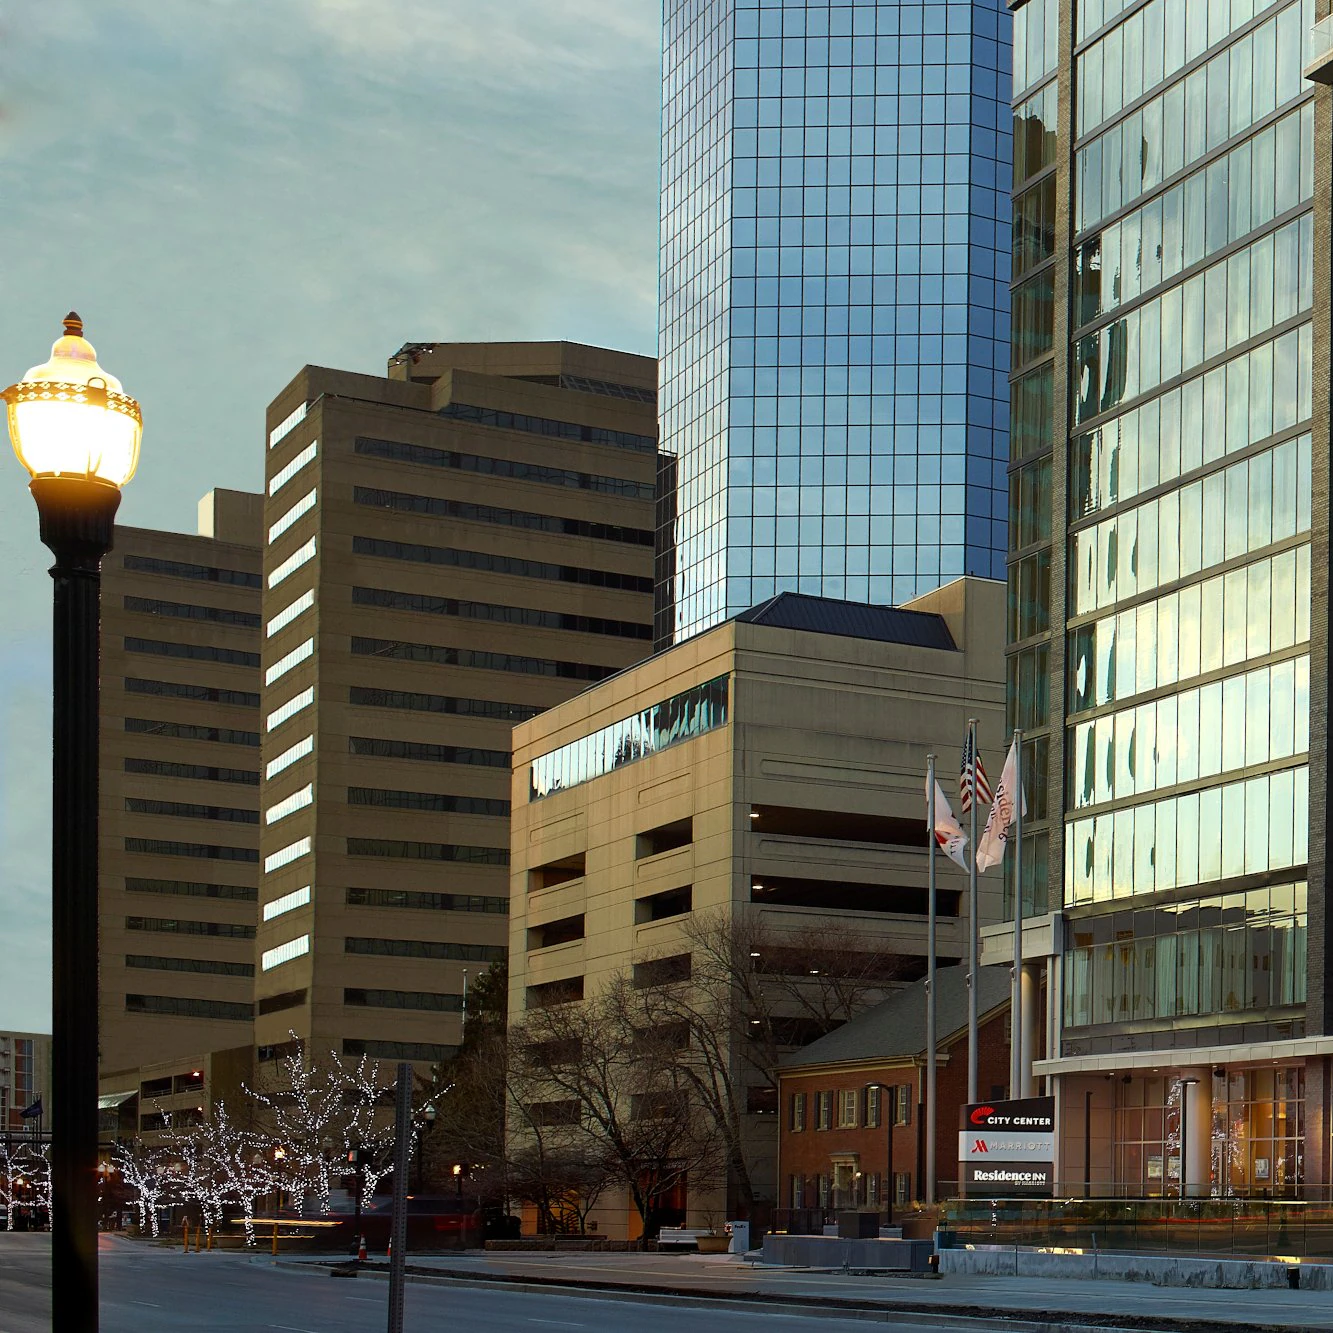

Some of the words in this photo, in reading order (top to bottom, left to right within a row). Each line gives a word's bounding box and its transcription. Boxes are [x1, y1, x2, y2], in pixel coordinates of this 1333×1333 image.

[987, 1116, 1011, 1125] CITY
[1013, 1117, 1051, 1126] CENTER
[989, 1141, 1051, 1151] MARRIOTT
[974, 1169, 1031, 1181] Residence
[1032, 1172, 1046, 1181] INN
